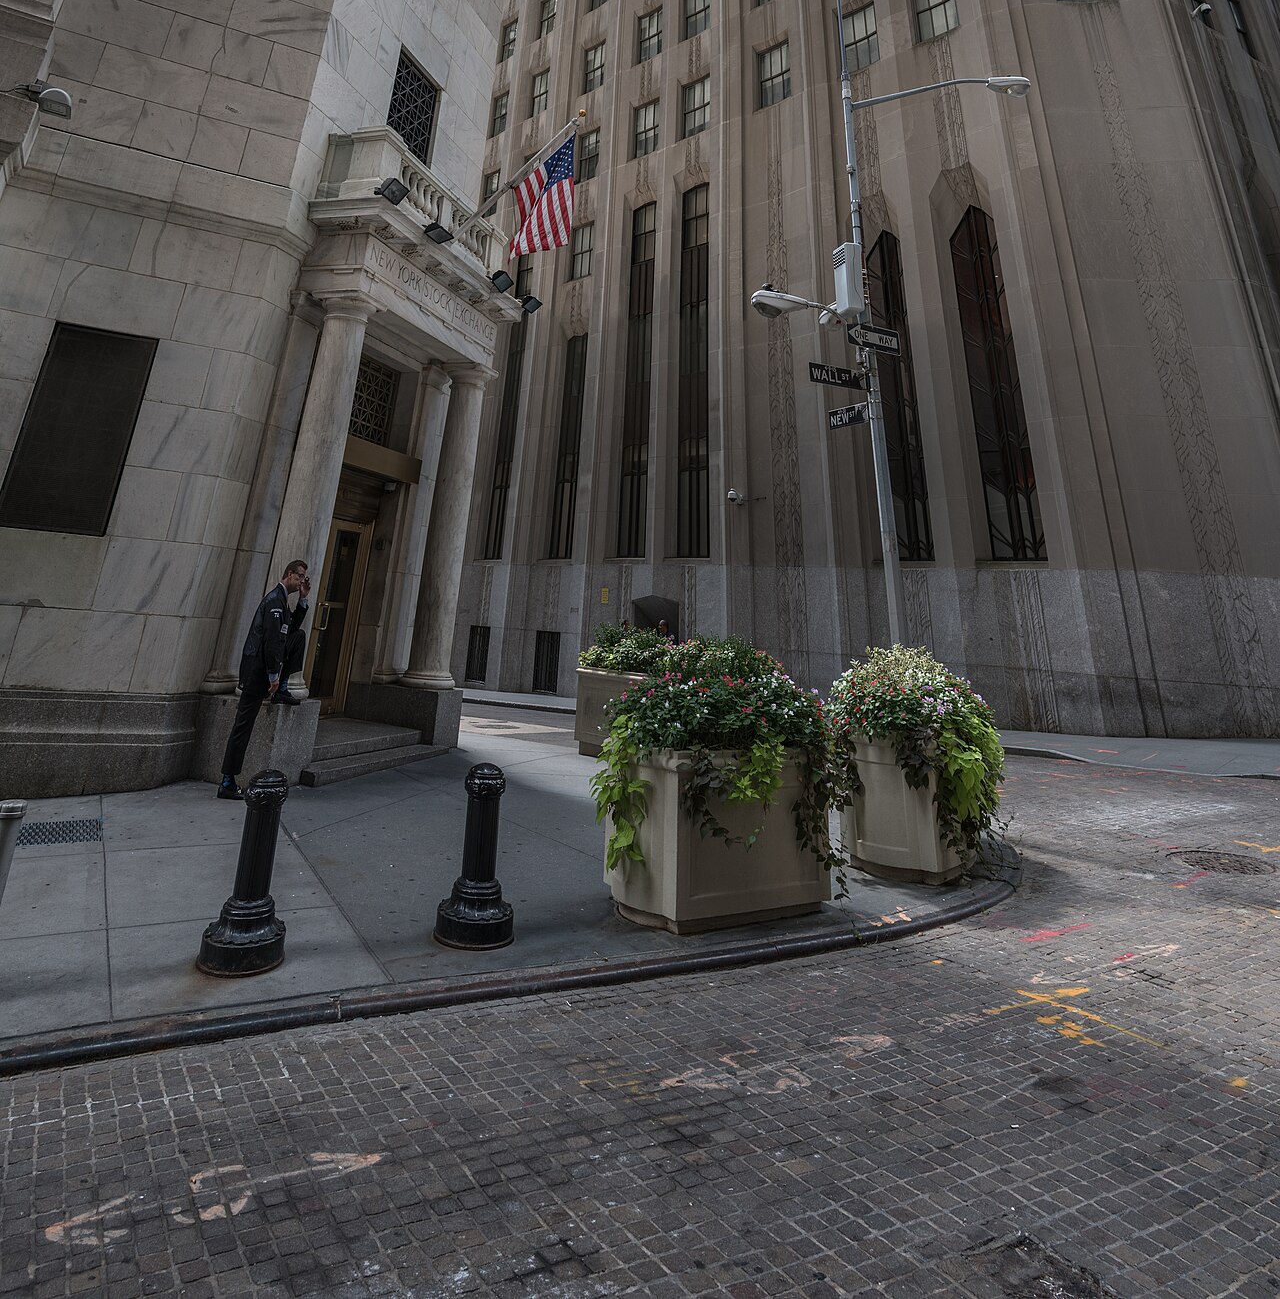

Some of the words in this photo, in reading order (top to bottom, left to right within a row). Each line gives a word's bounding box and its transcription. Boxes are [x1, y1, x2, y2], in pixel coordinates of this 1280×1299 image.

[370, 244, 395, 273] NEW
[397, 264, 421, 293] YORK
[423, 278, 451, 313] STOCK
[454, 302, 495, 342] EXCHANGE
[855, 330, 869, 341] ONE
[878, 335, 893, 347] WAY
[811, 367, 842, 383] WALL
[830, 412, 849, 427] NEW
[849, 410, 855, 418] ST
